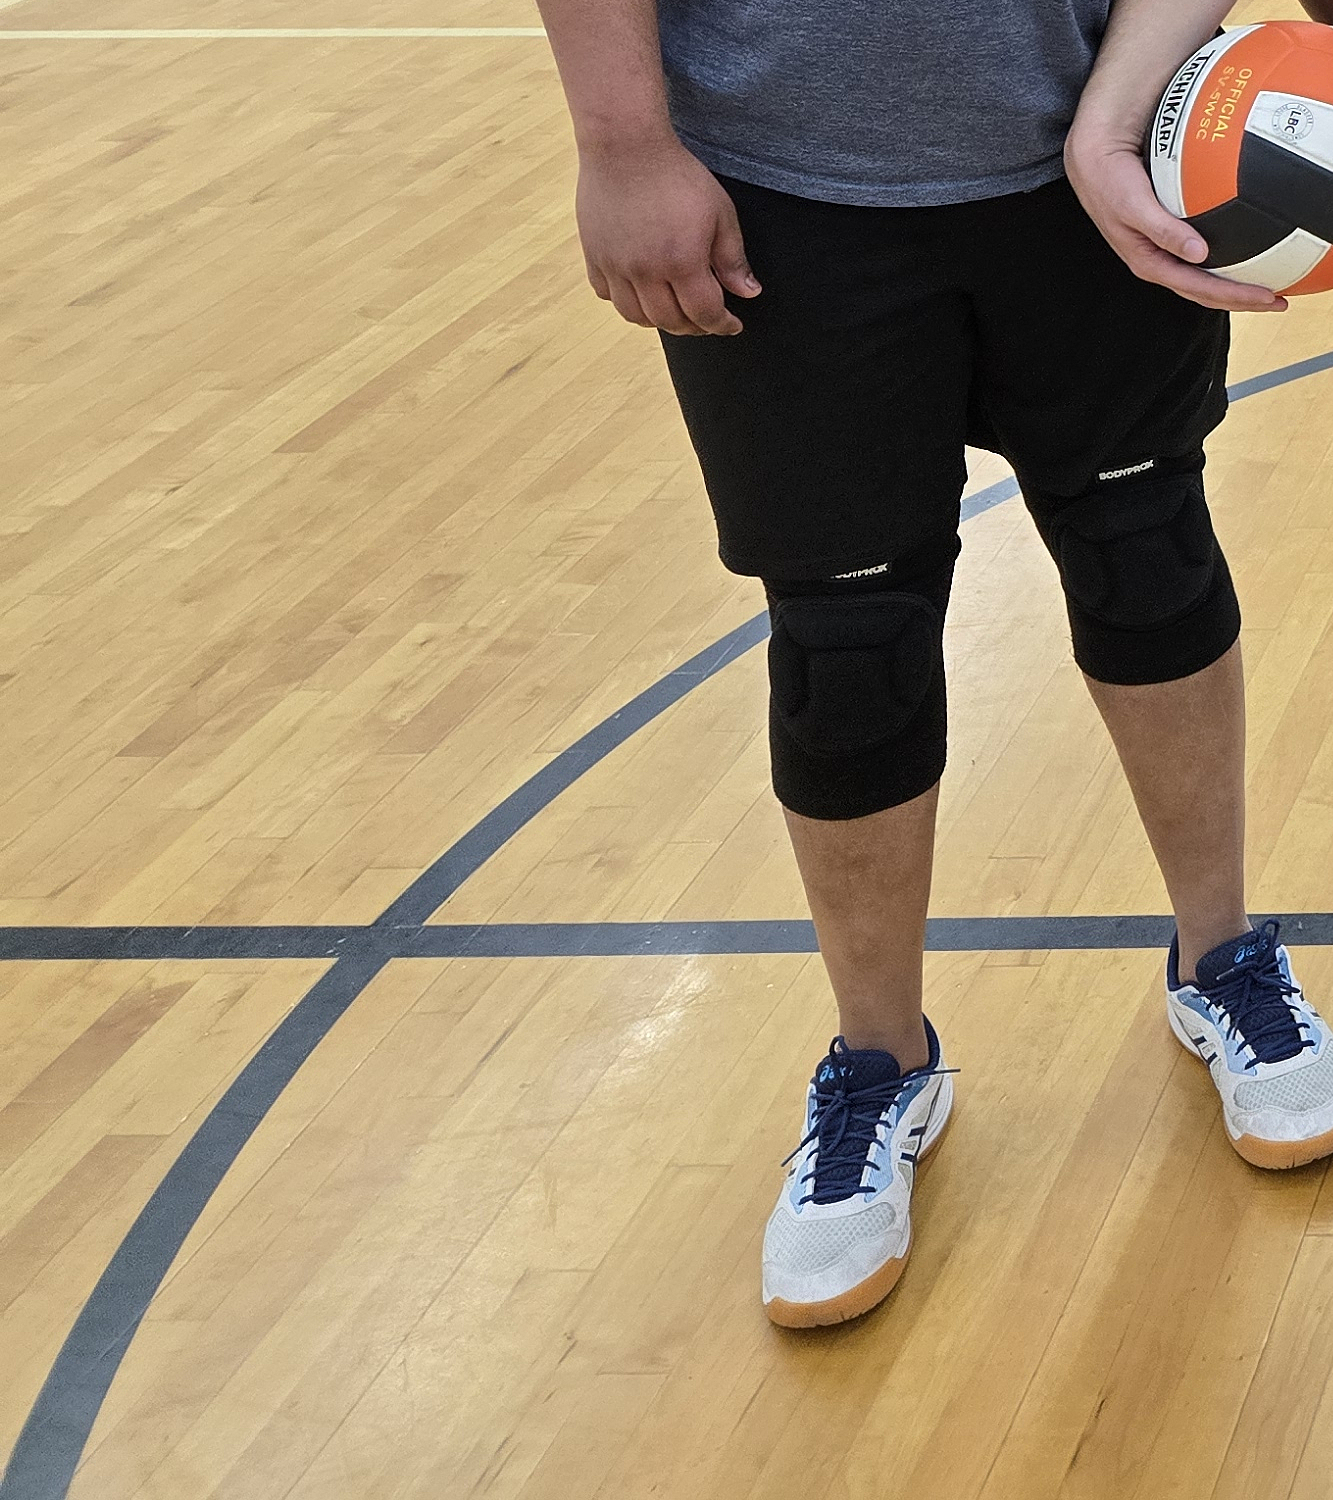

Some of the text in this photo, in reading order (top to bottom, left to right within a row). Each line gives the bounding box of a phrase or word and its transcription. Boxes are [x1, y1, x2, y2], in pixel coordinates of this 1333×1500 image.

[1158, 56, 1211, 153] TACHIKARA
[1211, 68, 1253, 142] OFFICIAL
[1284, 110, 1302, 134] LBC
[1098, 459, 1154, 481] BODYPROX
